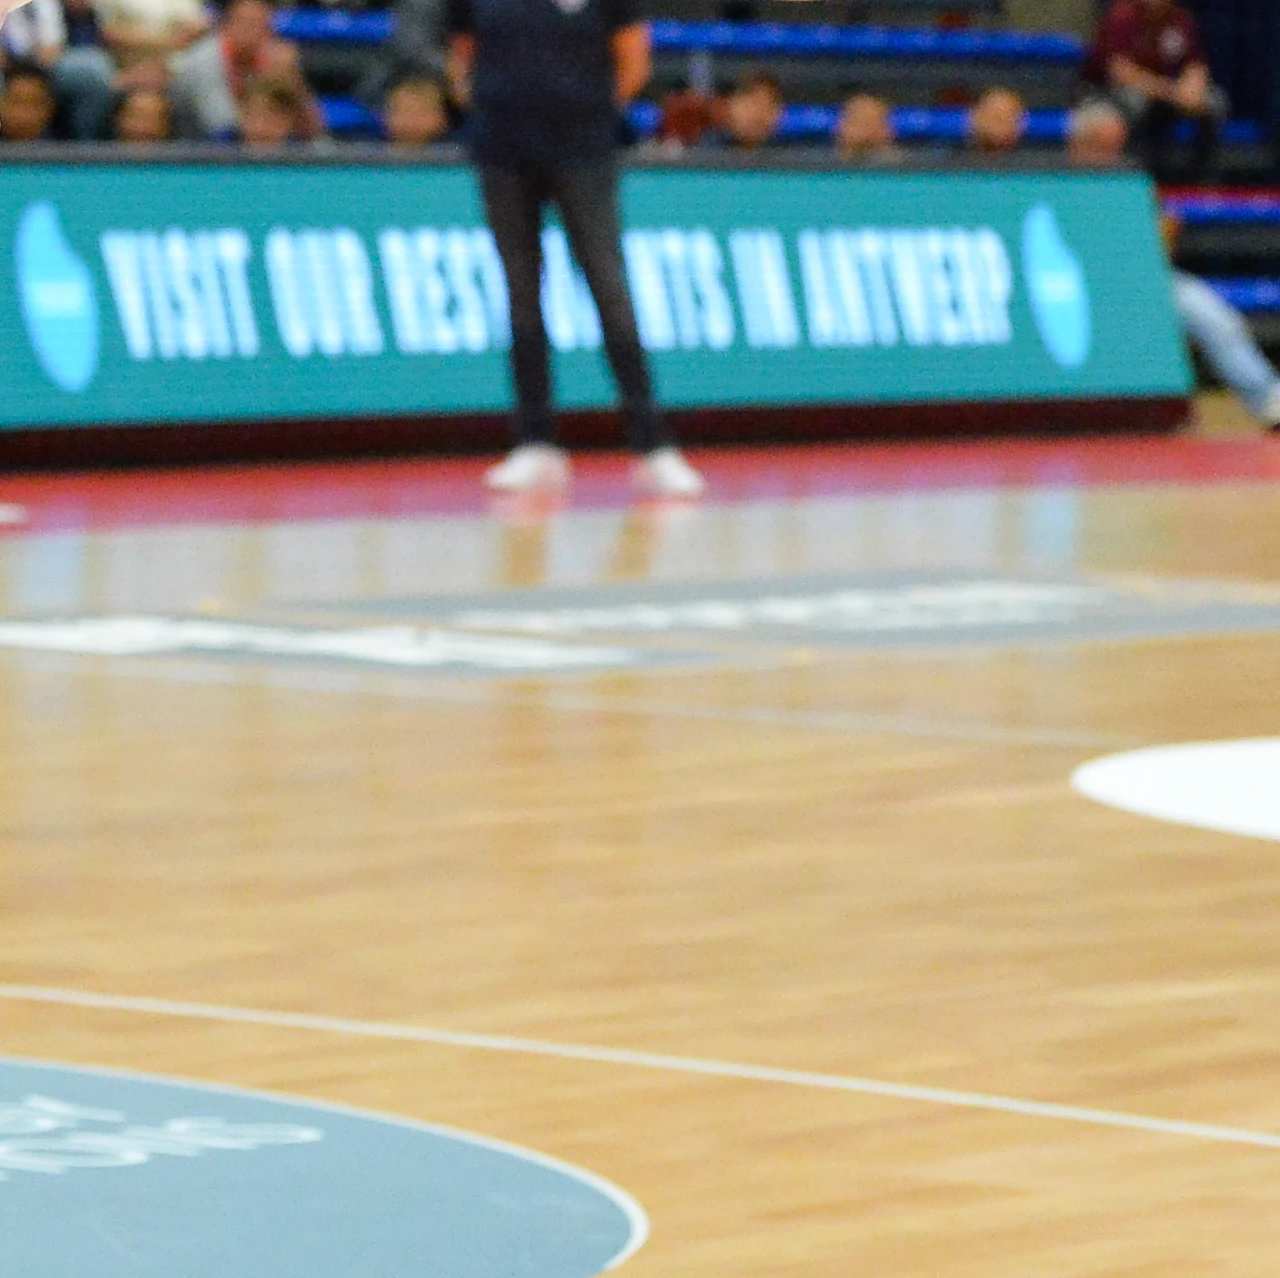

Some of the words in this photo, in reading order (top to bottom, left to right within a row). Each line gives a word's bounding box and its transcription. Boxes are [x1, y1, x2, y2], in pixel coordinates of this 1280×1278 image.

[100, 226, 260, 360] VISIT
[265, 225, 386, 357] OUR
[728, 225, 801, 350] IN
[797, 224, 1013, 347] ANTWERP
